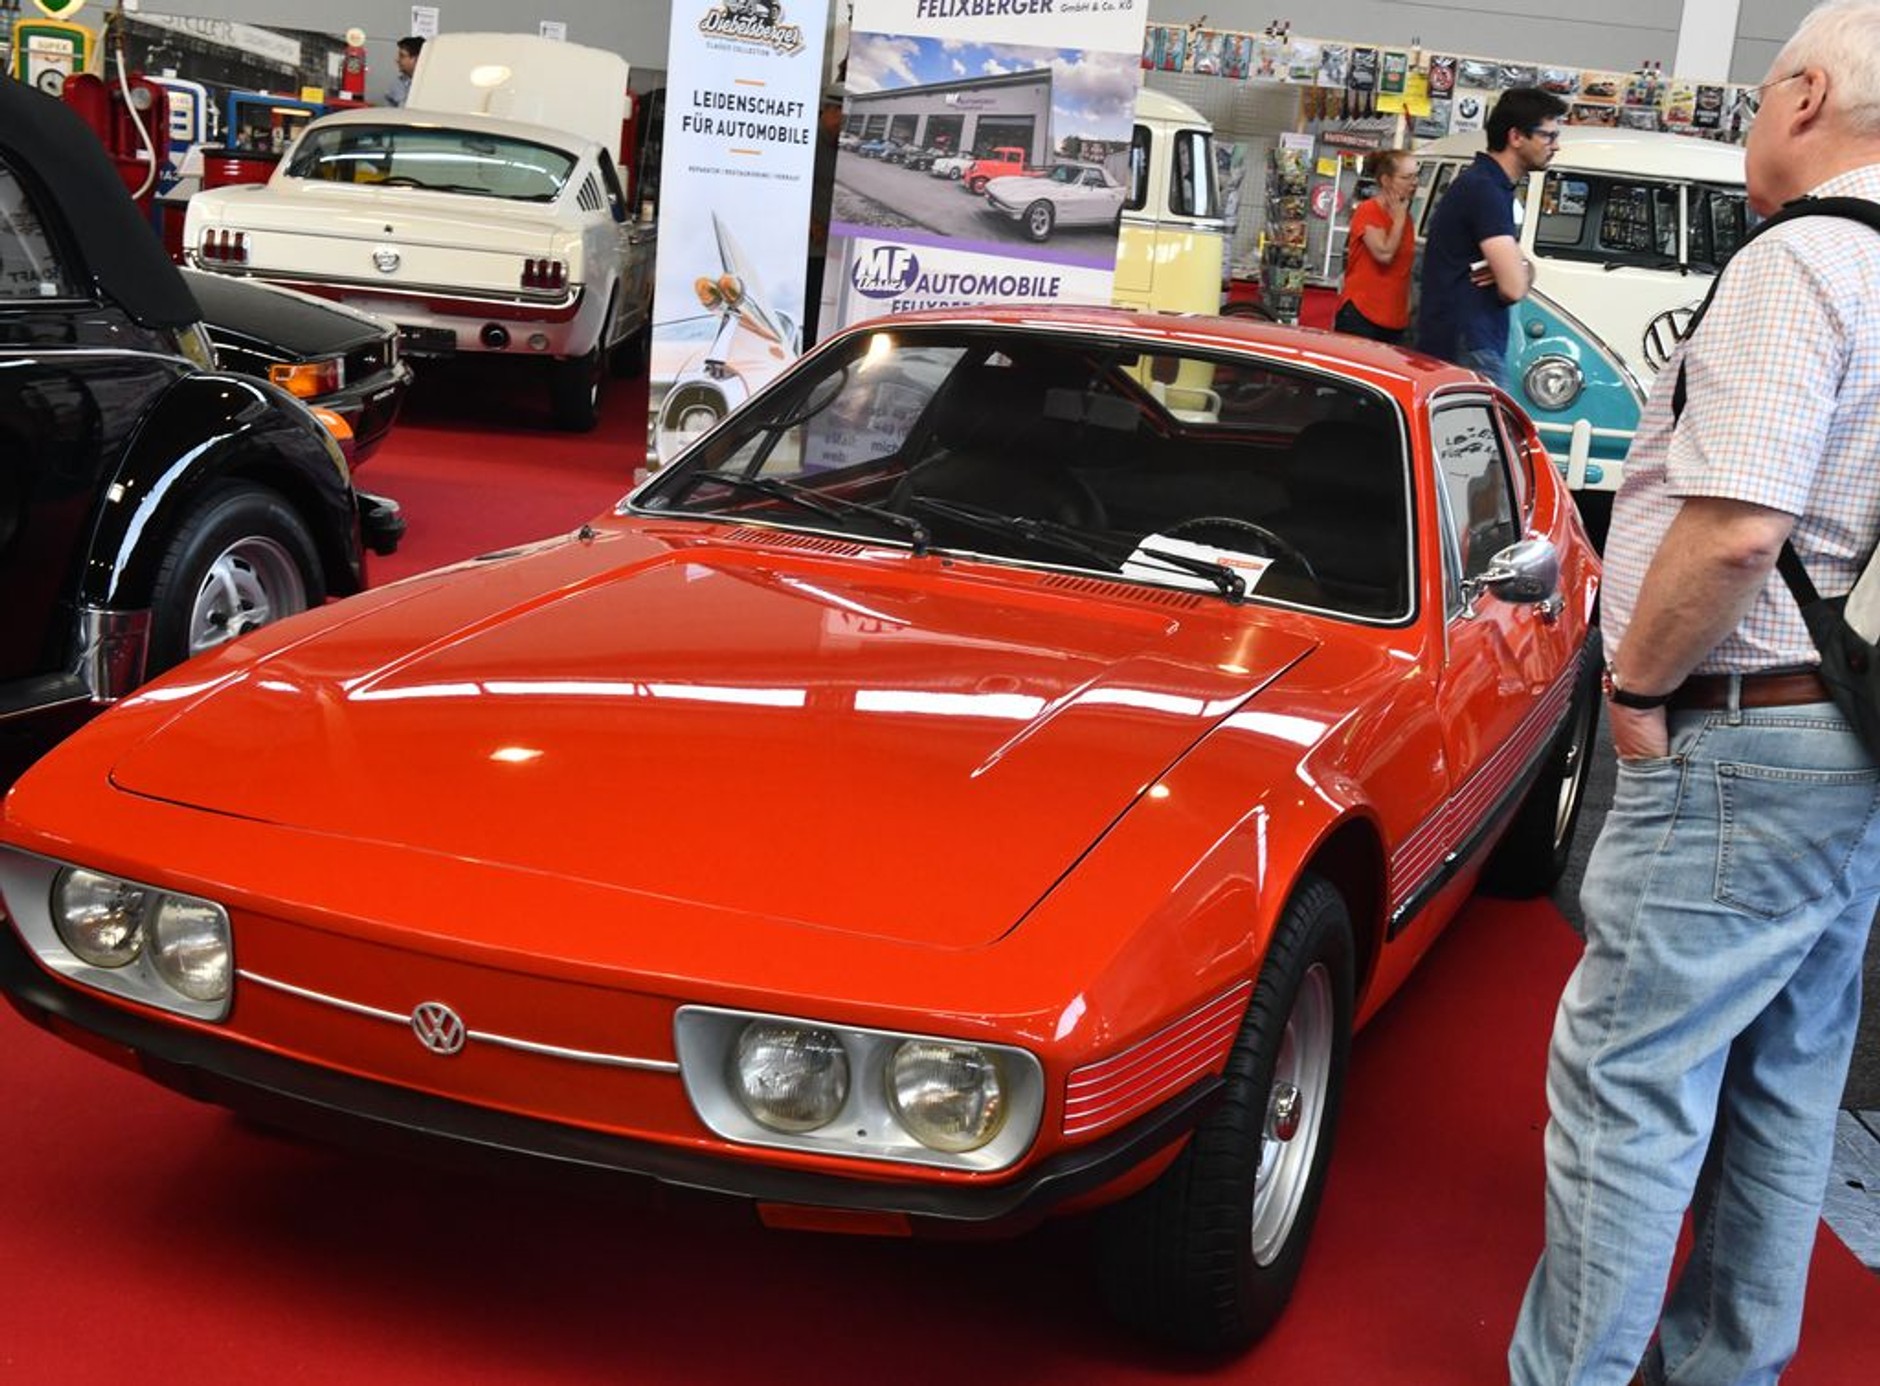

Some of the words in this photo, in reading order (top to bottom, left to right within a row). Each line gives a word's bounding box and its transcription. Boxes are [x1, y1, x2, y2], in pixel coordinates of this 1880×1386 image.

[693, 90, 804, 118] LEIDENSCHAFT
[682, 111, 713, 135] FÜR
[716, 119, 809, 145] AUTOMOBILE
[914, 273, 1060, 297] AUTOMOBILE
[413, 1002, 464, 1054] VW
